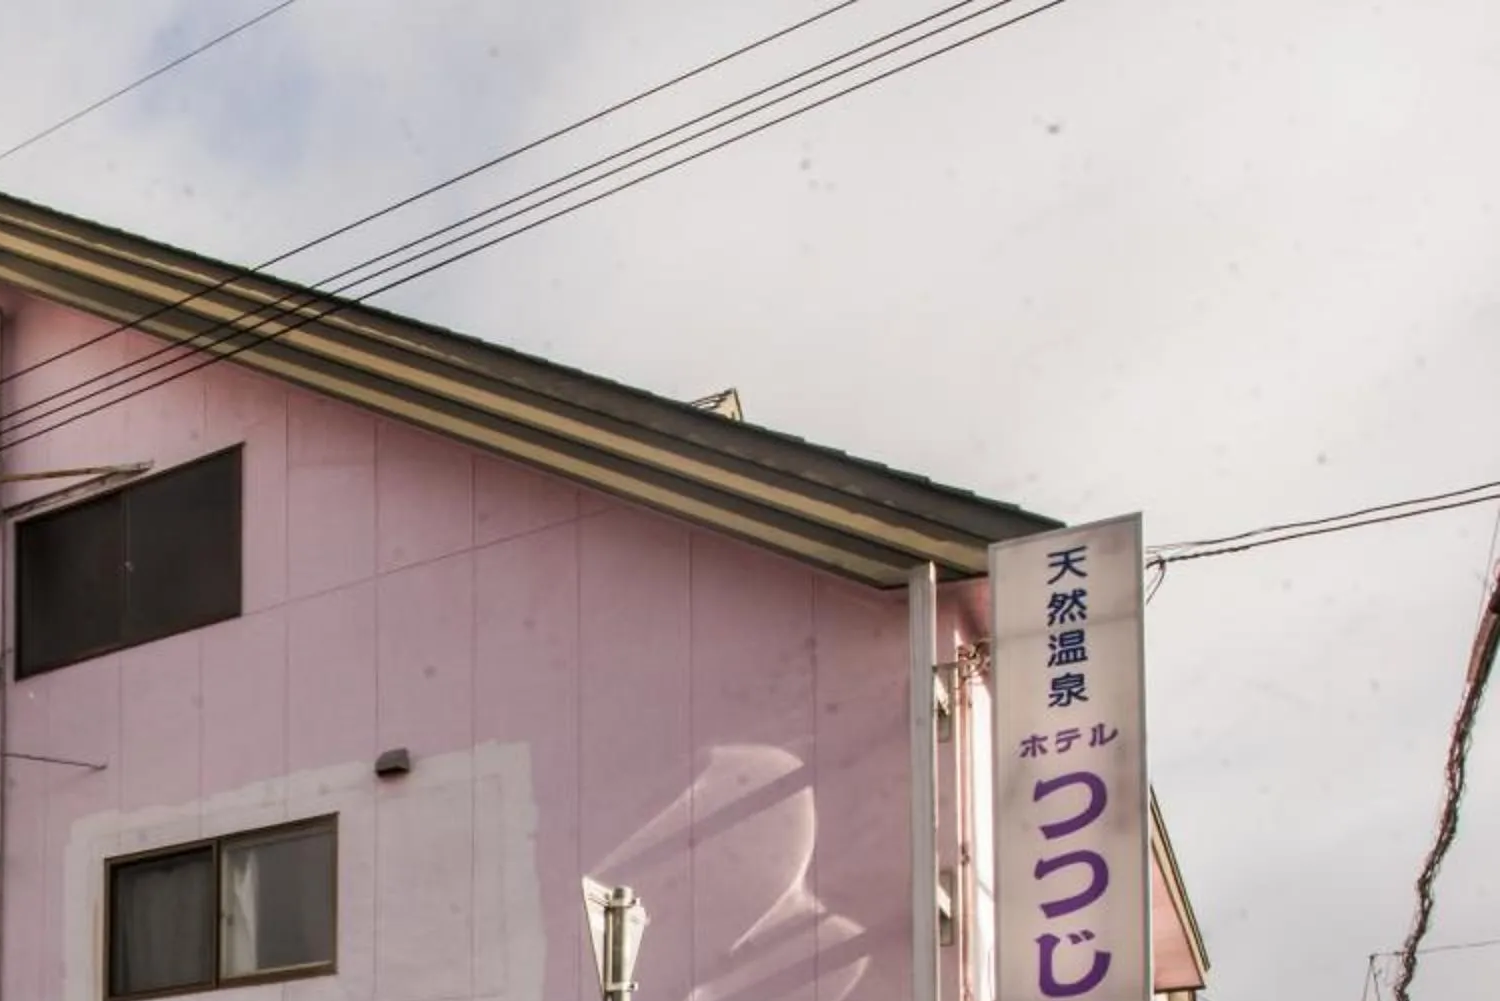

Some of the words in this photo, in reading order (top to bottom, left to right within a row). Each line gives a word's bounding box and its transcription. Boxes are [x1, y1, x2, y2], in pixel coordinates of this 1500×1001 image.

[1045, 544, 1090, 708] 天然温泉
[1018, 720, 1120, 759] ホテル
